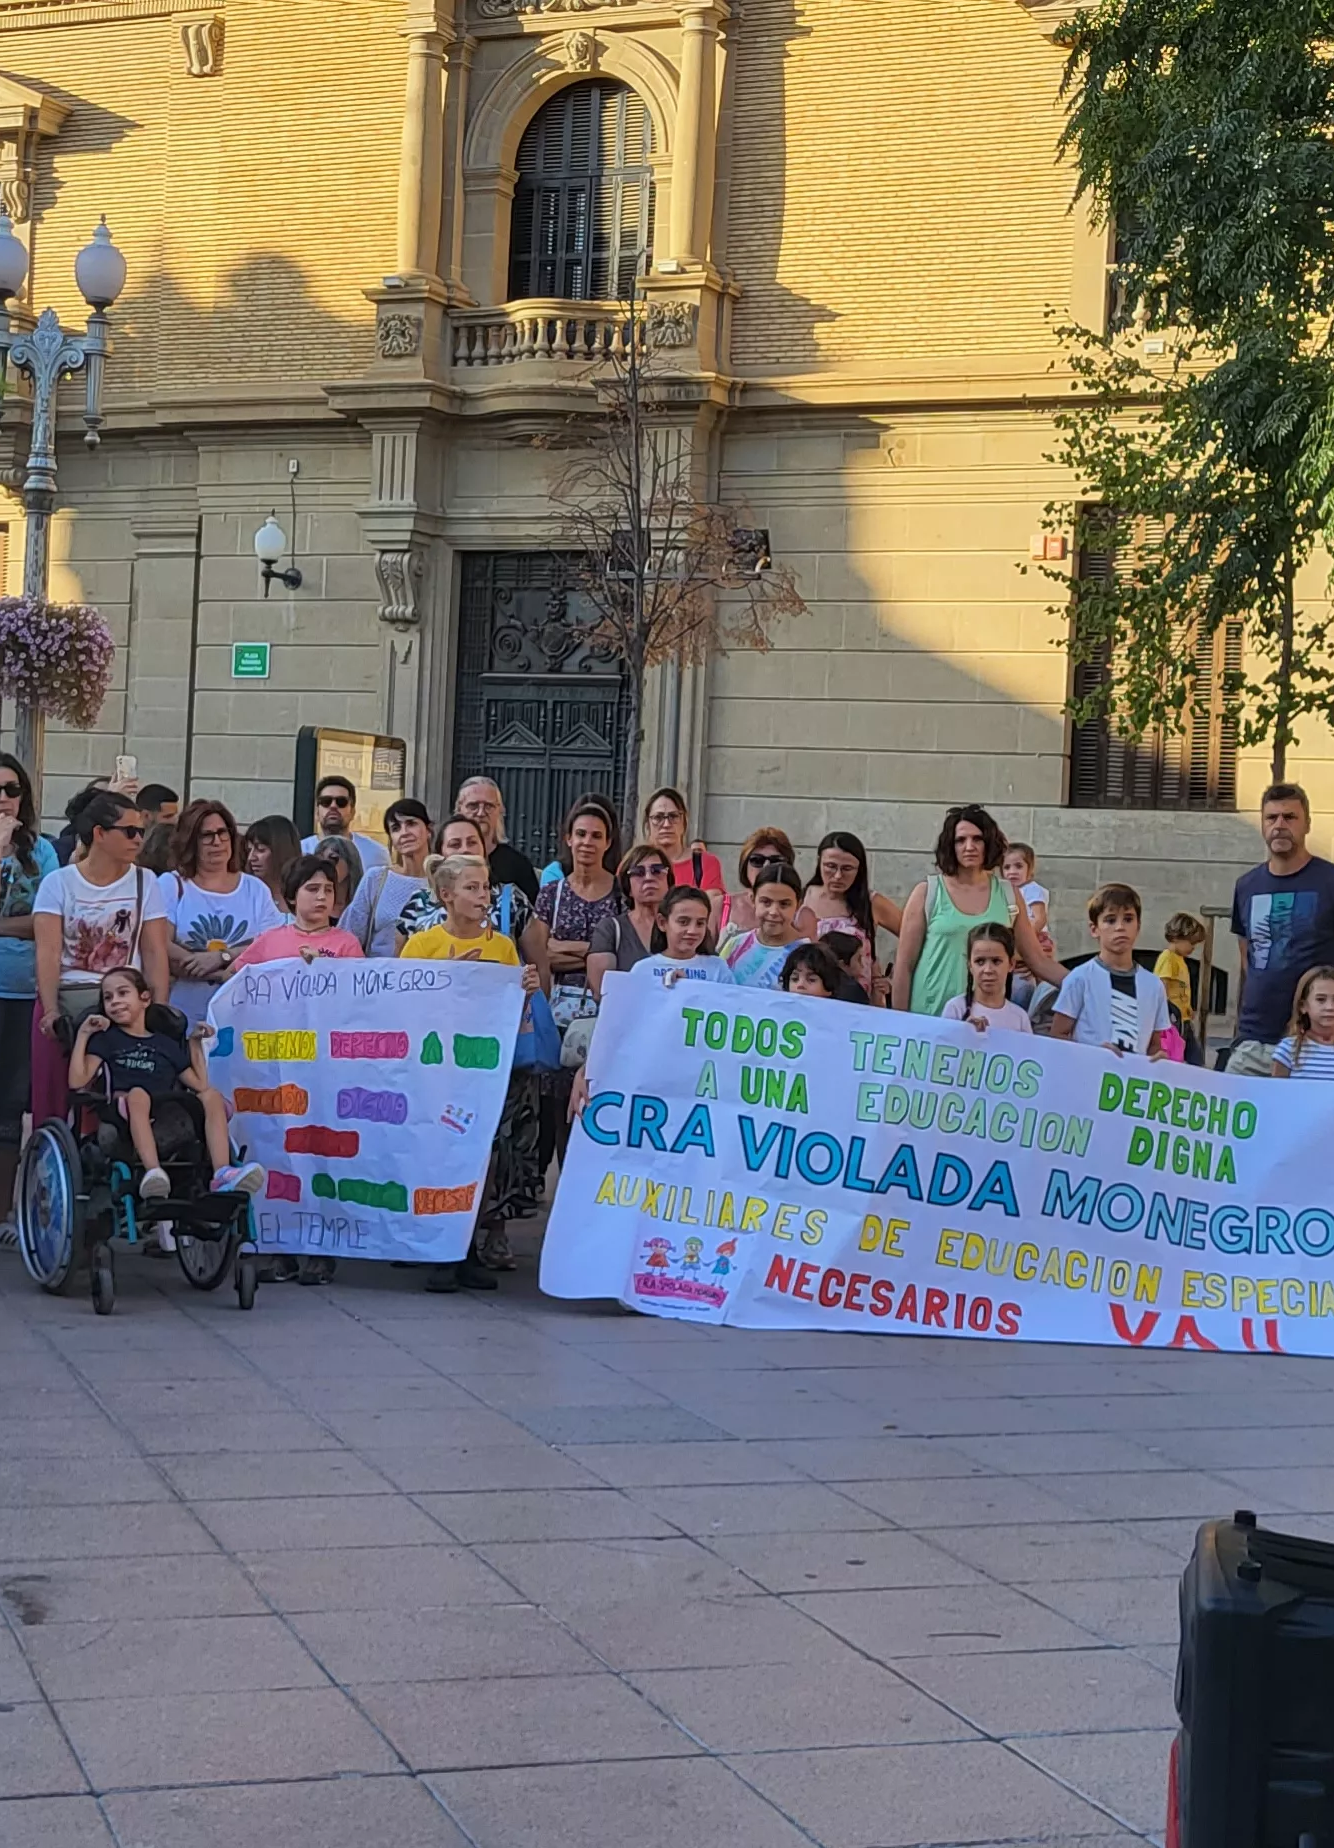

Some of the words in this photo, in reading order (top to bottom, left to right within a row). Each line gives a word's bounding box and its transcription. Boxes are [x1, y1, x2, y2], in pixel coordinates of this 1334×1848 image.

[681, 1007, 807, 1059] TODOS
[849, 1030, 1044, 1099] TENEMOS
[1098, 1072, 1258, 1139] DERECHO
[695, 1060, 719, 1100] A
[740, 1066, 809, 1114] UNA
[856, 1082, 1093, 1157] EDUCACION
[1127, 1126, 1237, 1185] DIGNA
[581, 1091, 716, 1158] CRA
[738, 1115, 1021, 1218] VIOLADA
[259, 1211, 287, 1245] EL
[292, 1211, 371, 1250] TEMPLE
[594, 1171, 829, 1245] AUXILIARES
[858, 1214, 910, 1258] DE
[935, 1228, 1163, 1304] EDUCACION
[764, 1254, 1023, 1336] NECESARIOS
